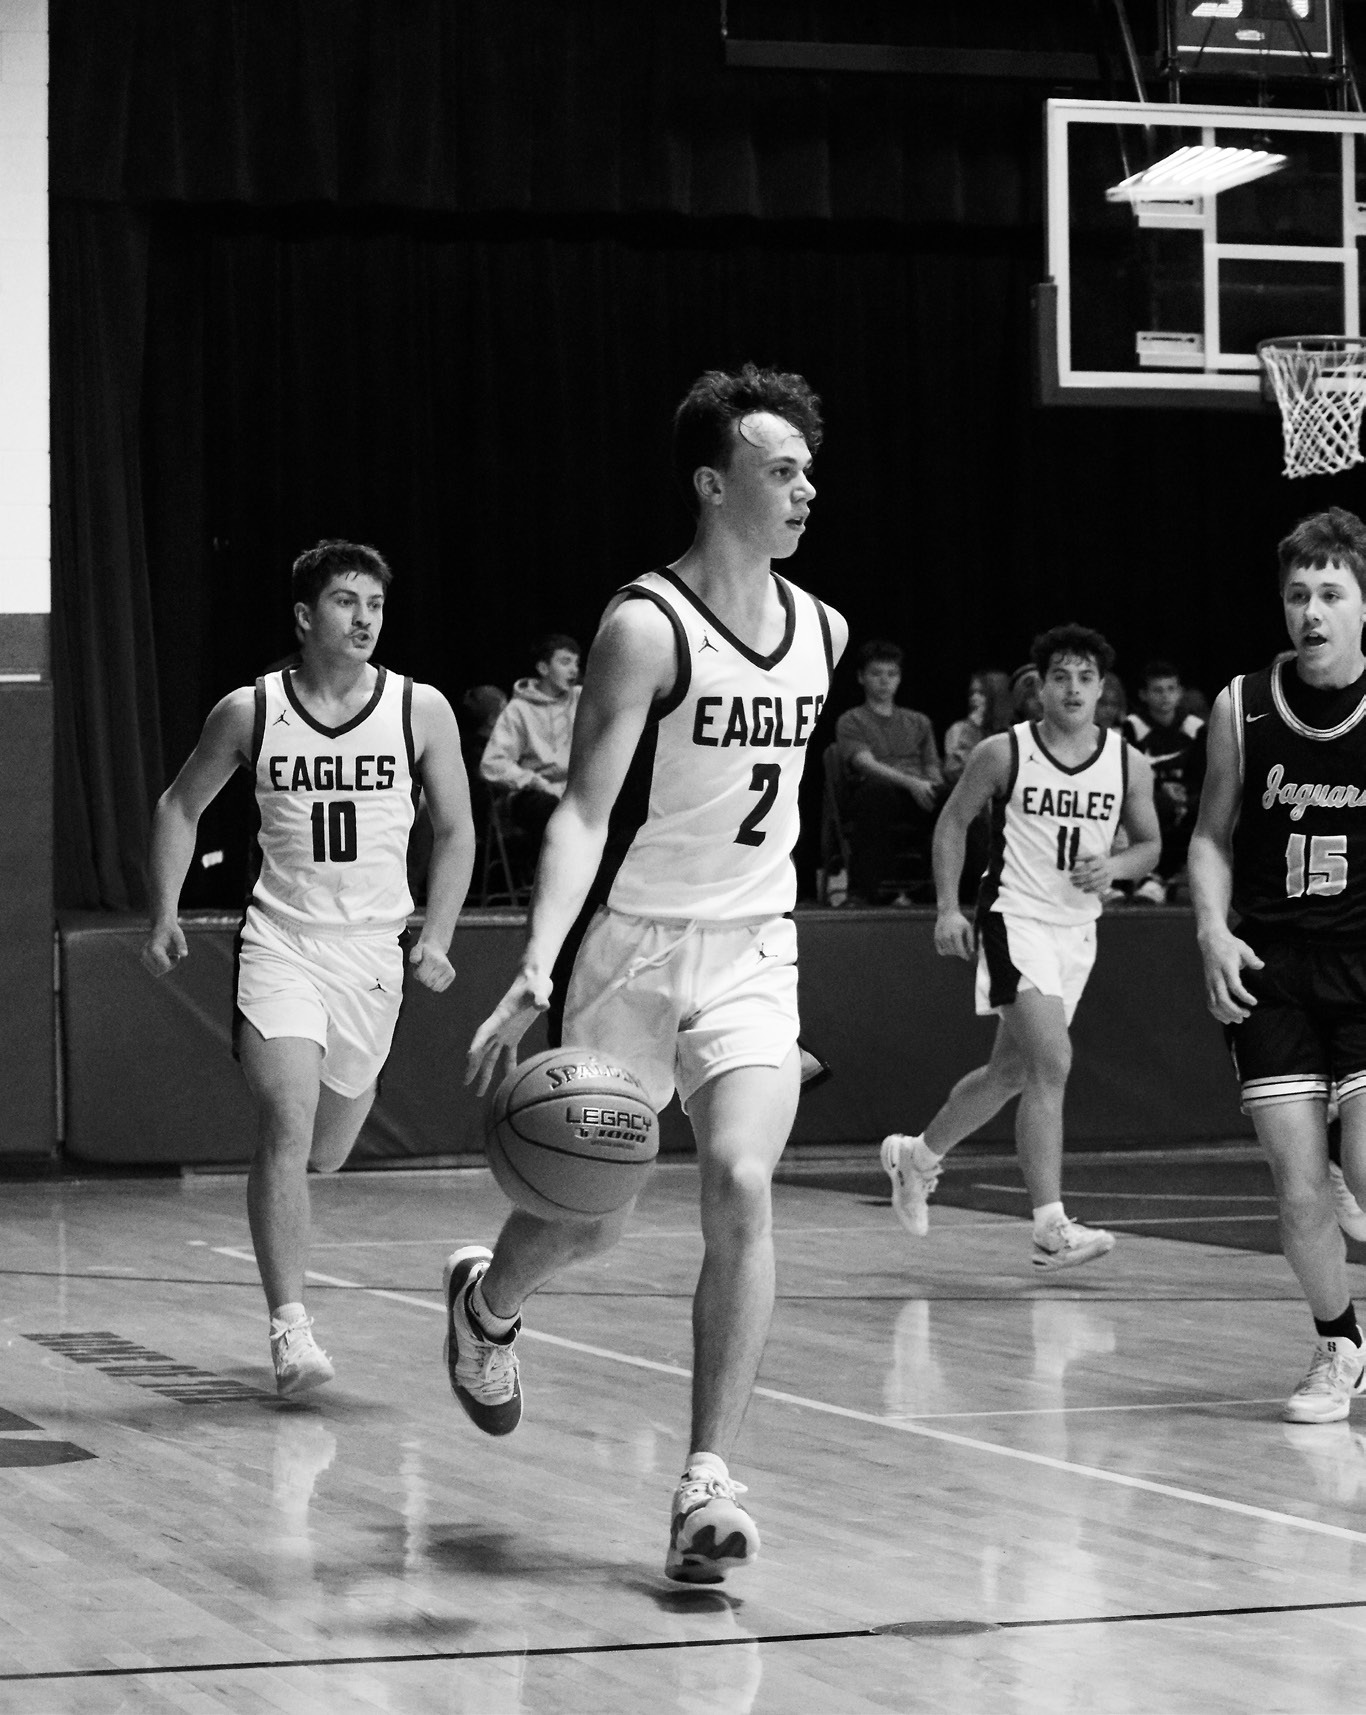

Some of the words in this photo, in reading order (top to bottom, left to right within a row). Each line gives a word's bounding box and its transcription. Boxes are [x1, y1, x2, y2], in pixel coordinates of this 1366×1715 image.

[269, 755, 396, 792] EAGLES
[733, 763, 782, 847] 2
[1023, 786, 1115, 821] EAGLES
[310, 800, 358, 863] 10
[1056, 825, 1080, 872] 11
[1285, 833, 1348, 898] 15
[566, 1107, 652, 1132] LEGACY
